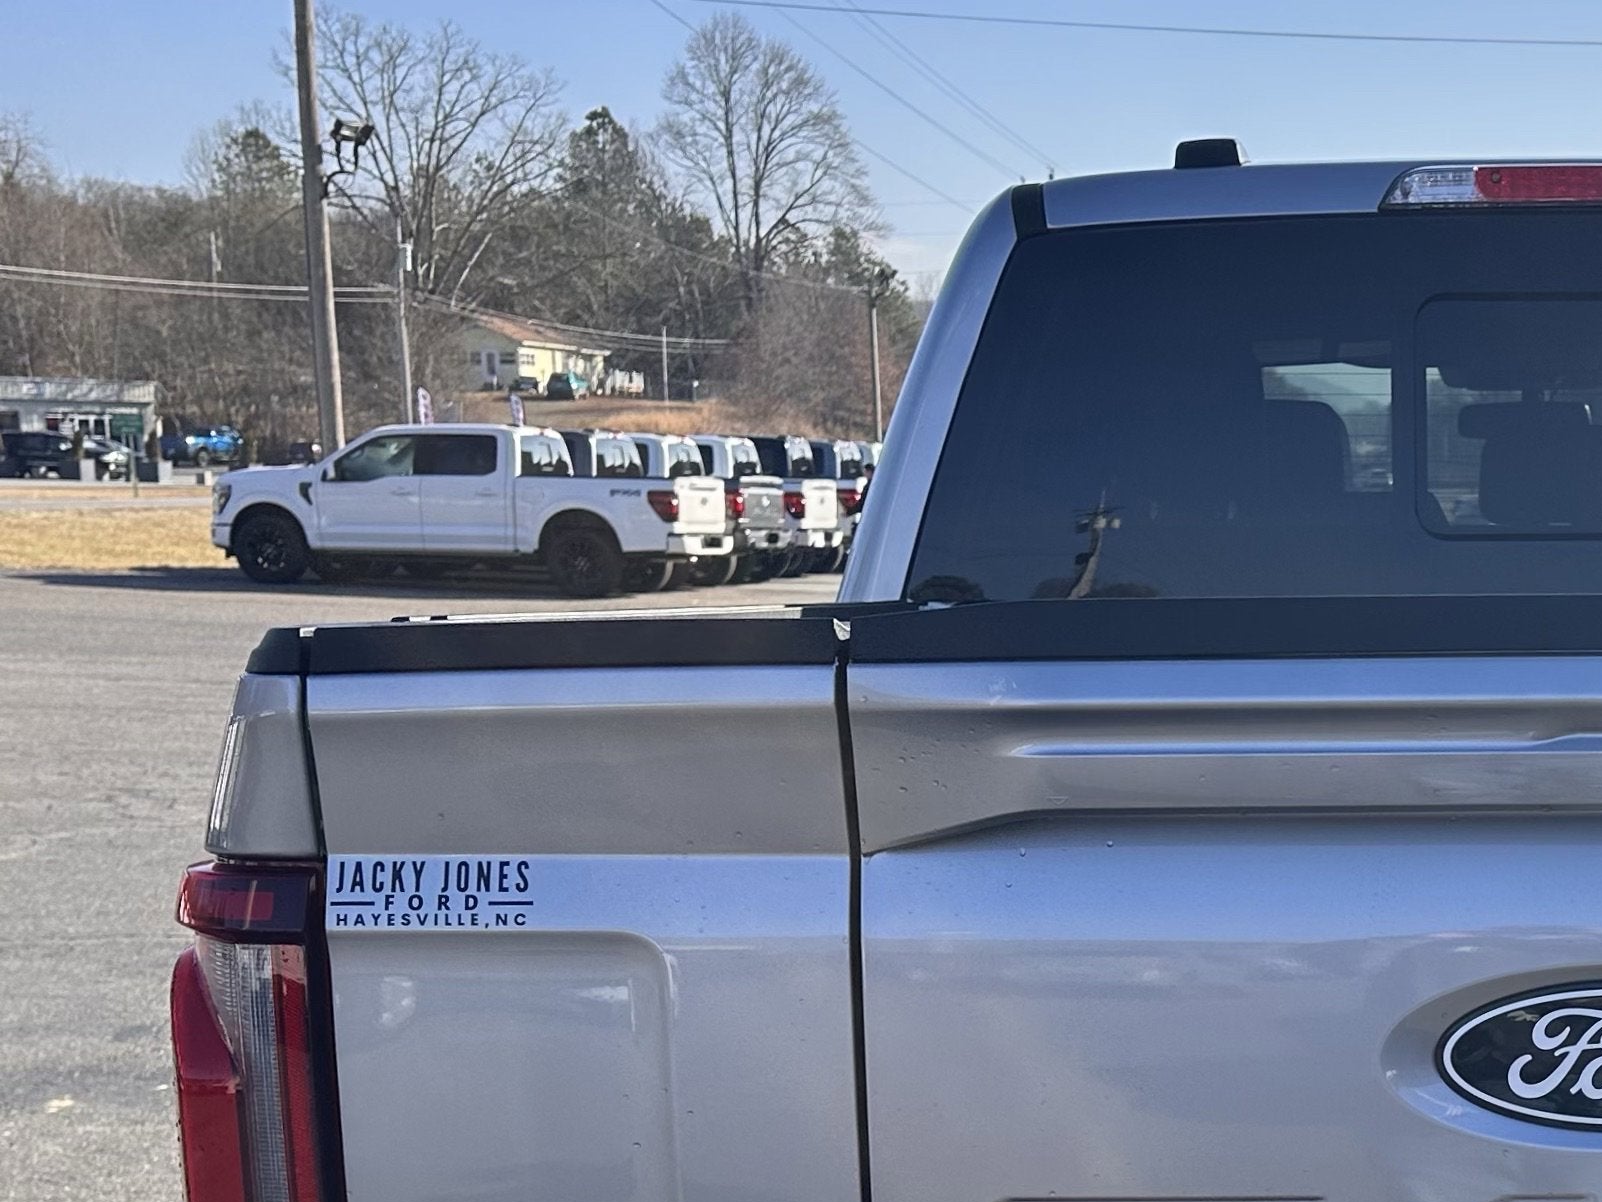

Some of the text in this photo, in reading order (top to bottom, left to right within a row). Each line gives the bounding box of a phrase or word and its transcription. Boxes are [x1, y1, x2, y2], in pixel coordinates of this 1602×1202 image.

[335, 860, 530, 893] JACKY JONES
[384, 894, 479, 911] FORD
